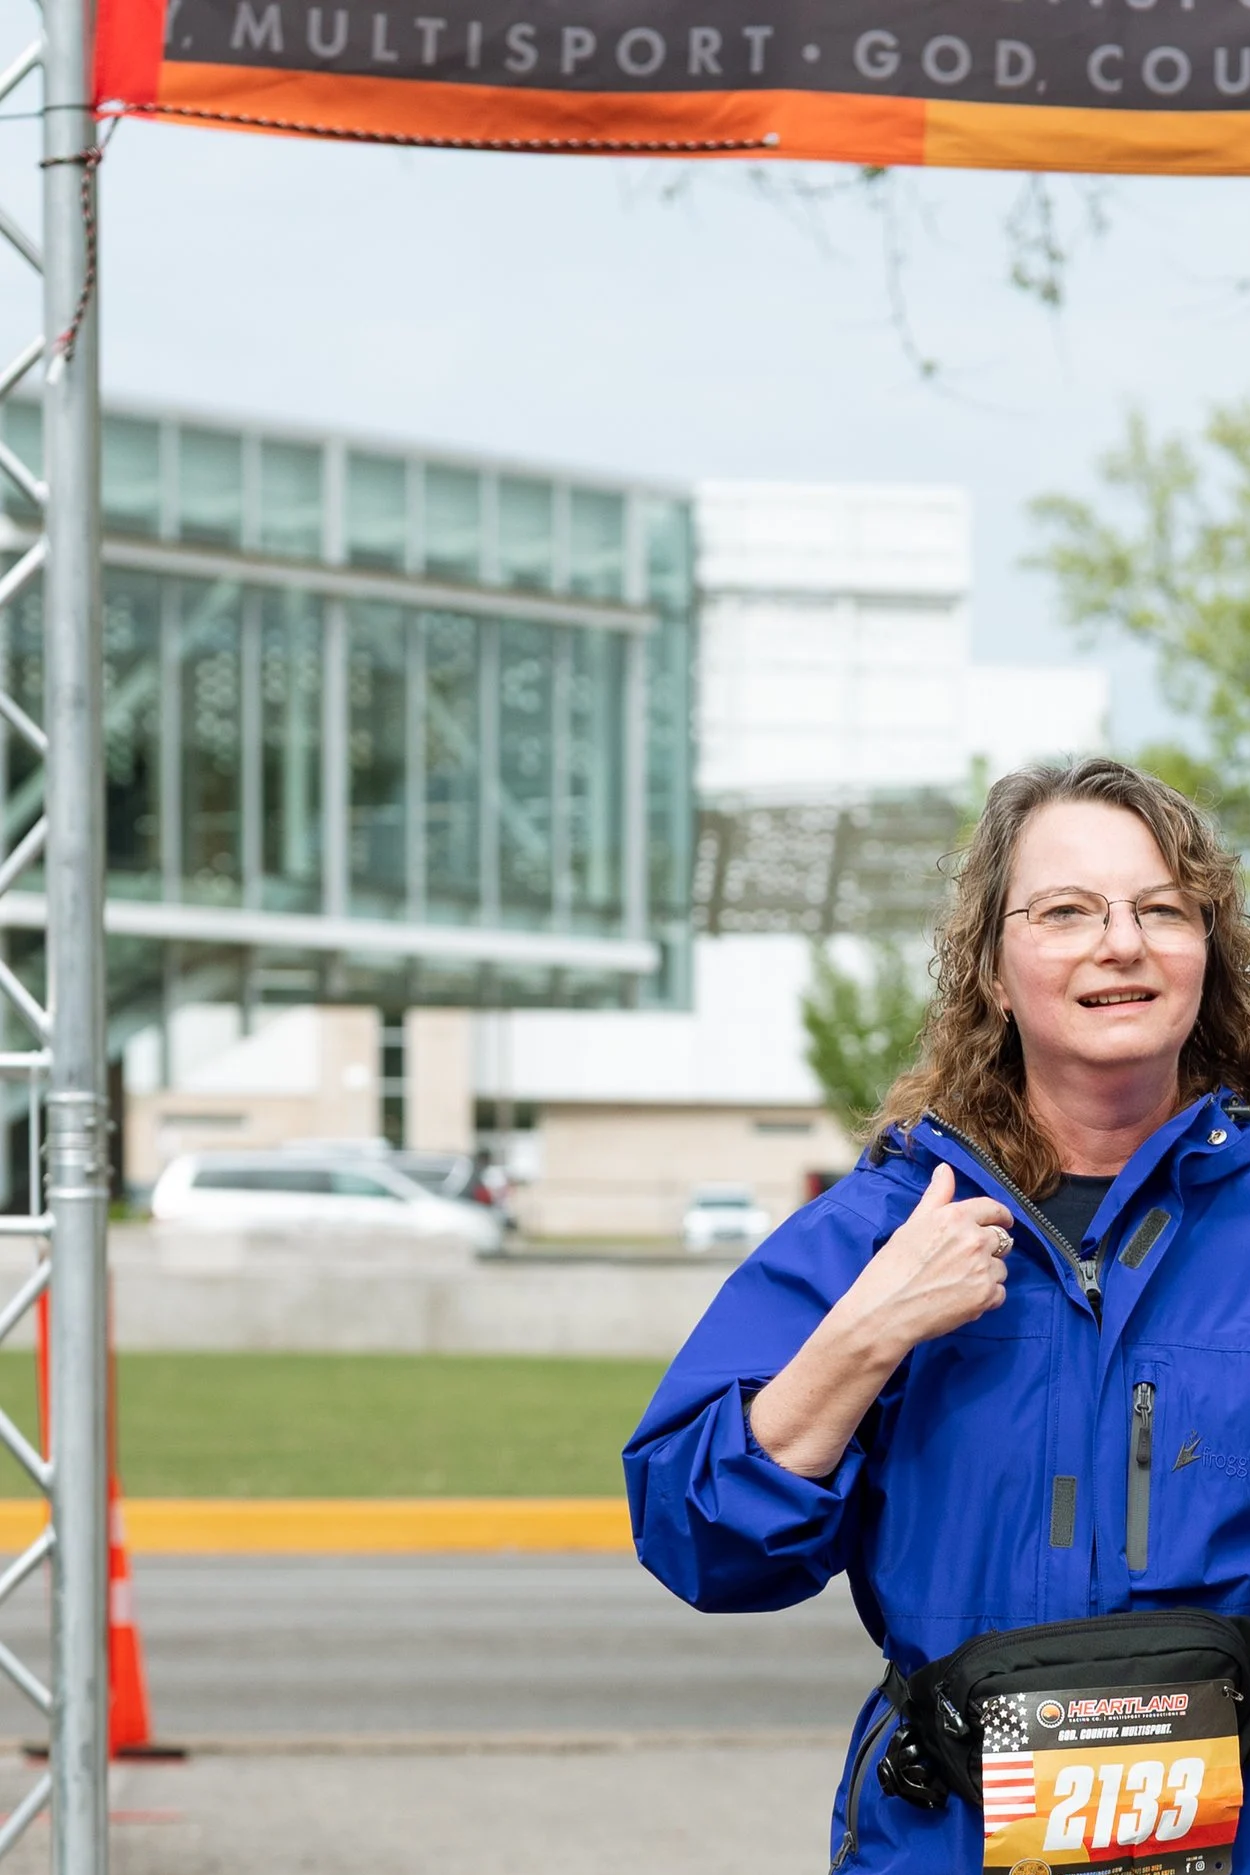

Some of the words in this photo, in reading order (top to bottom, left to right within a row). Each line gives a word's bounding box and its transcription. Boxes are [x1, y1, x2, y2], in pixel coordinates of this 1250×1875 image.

[231, 1, 773, 75] MULTISPORT
[853, 29, 1046, 92] GOD,
[1202, 1447, 1249, 1477] frogg
[1067, 1693, 1189, 1718] HEARTLAND
[1080, 1726, 1119, 1740] COUNTRY.
[1121, 1723, 1172, 1738] MULTISPORT.
[1043, 1757, 1205, 1852] 2133
